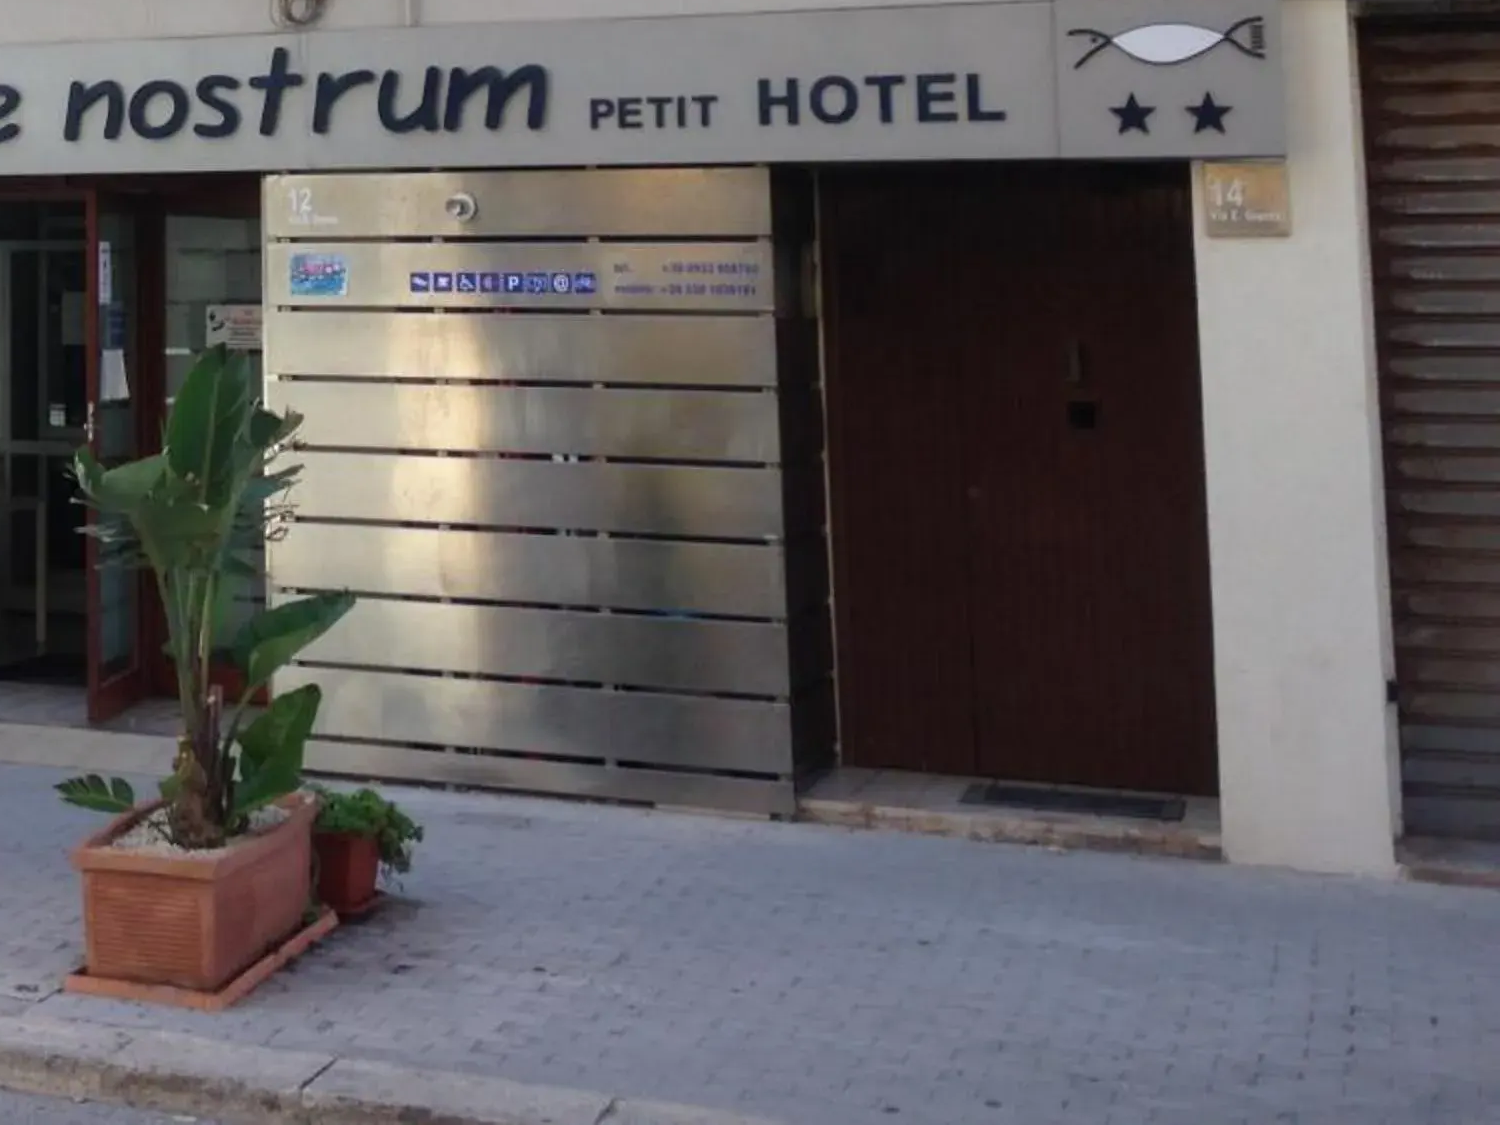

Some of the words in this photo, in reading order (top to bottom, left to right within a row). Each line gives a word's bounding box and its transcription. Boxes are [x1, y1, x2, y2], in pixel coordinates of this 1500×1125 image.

[63, 46, 550, 142] nostrum
[589, 94, 719, 131] PETIT
[756, 72, 1007, 127] HOTEL
[288, 187, 312, 213] 12
[1210, 178, 1243, 207] 14
